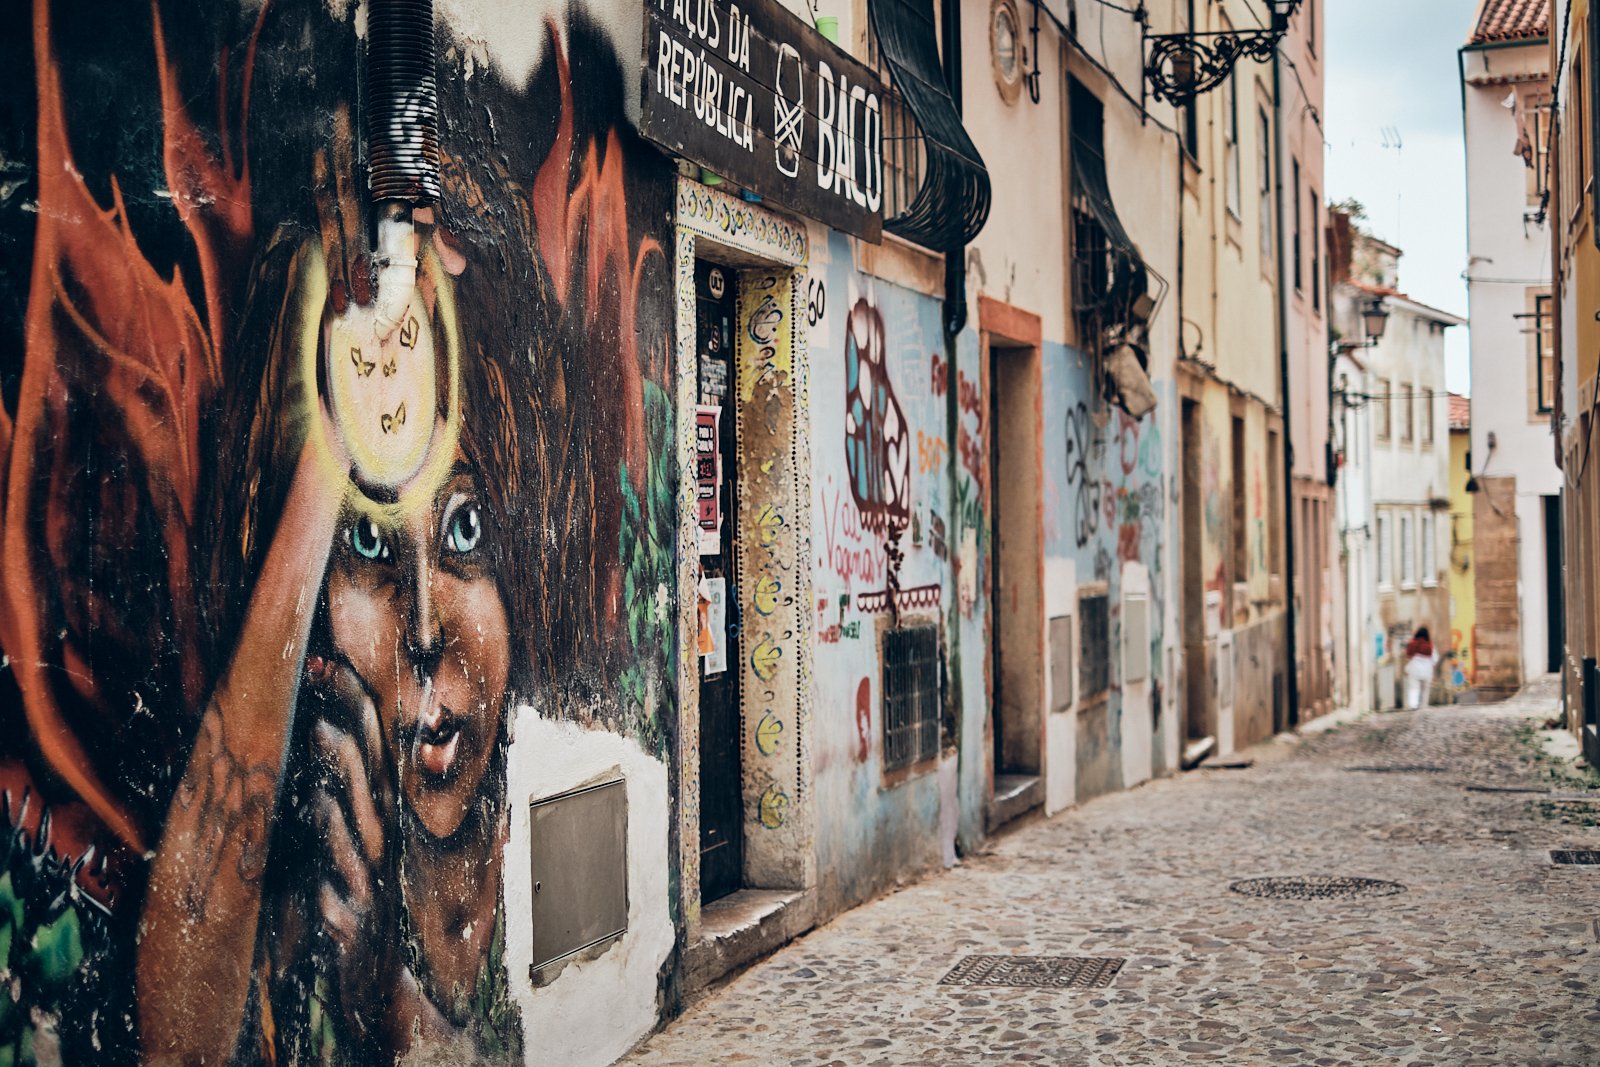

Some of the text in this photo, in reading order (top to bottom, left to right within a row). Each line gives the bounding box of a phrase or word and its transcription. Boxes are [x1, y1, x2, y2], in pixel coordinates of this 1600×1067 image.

[657, 30, 753, 152] REPÚBLICA
[660, 0, 750, 73] ÇOS DA
[817, 60, 882, 213] BACO
